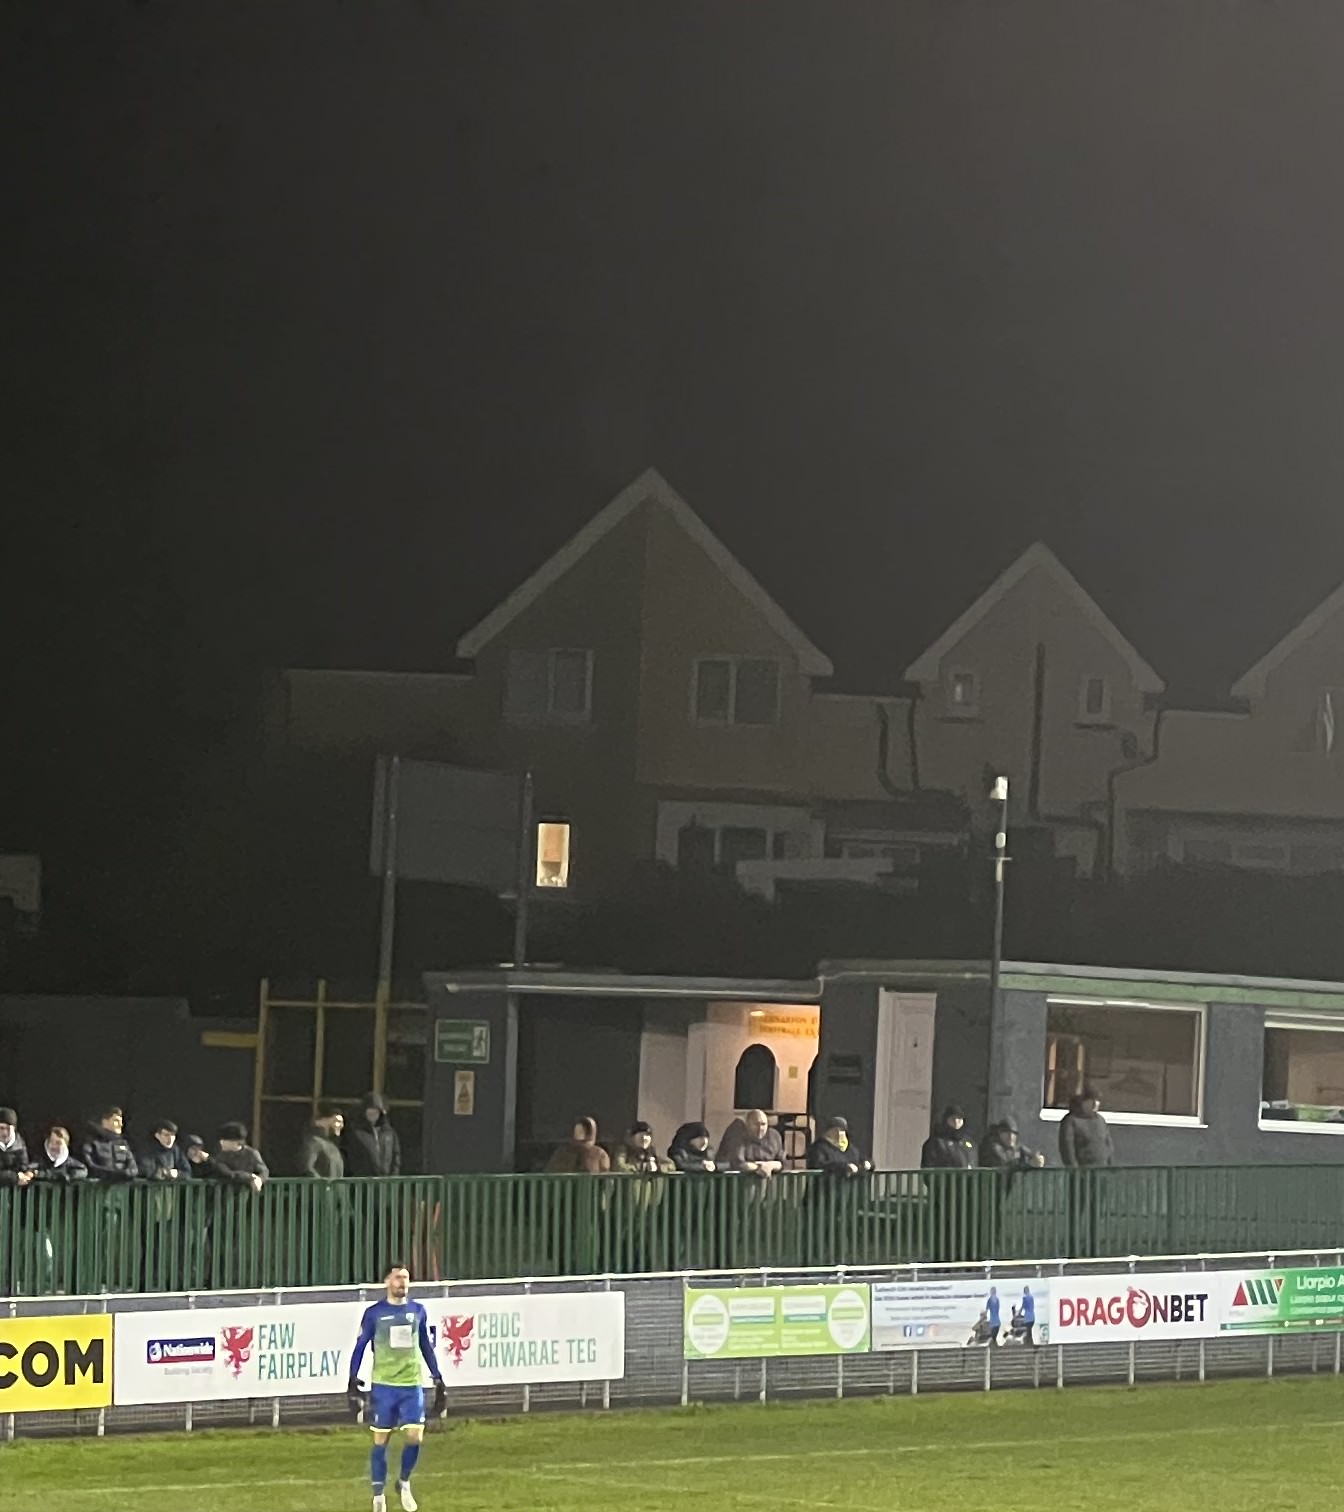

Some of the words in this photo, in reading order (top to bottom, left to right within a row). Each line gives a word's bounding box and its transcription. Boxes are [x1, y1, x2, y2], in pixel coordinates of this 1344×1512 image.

[1059, 1286, 1208, 1328] DRAGONBET
[258, 1322, 295, 1350] FAW
[478, 1312, 520, 1339] CBDC
[258, 1350, 341, 1380] FAIRPLAY
[478, 1340, 559, 1368] CHWARAE
[566, 1338, 597, 1364] TEG
